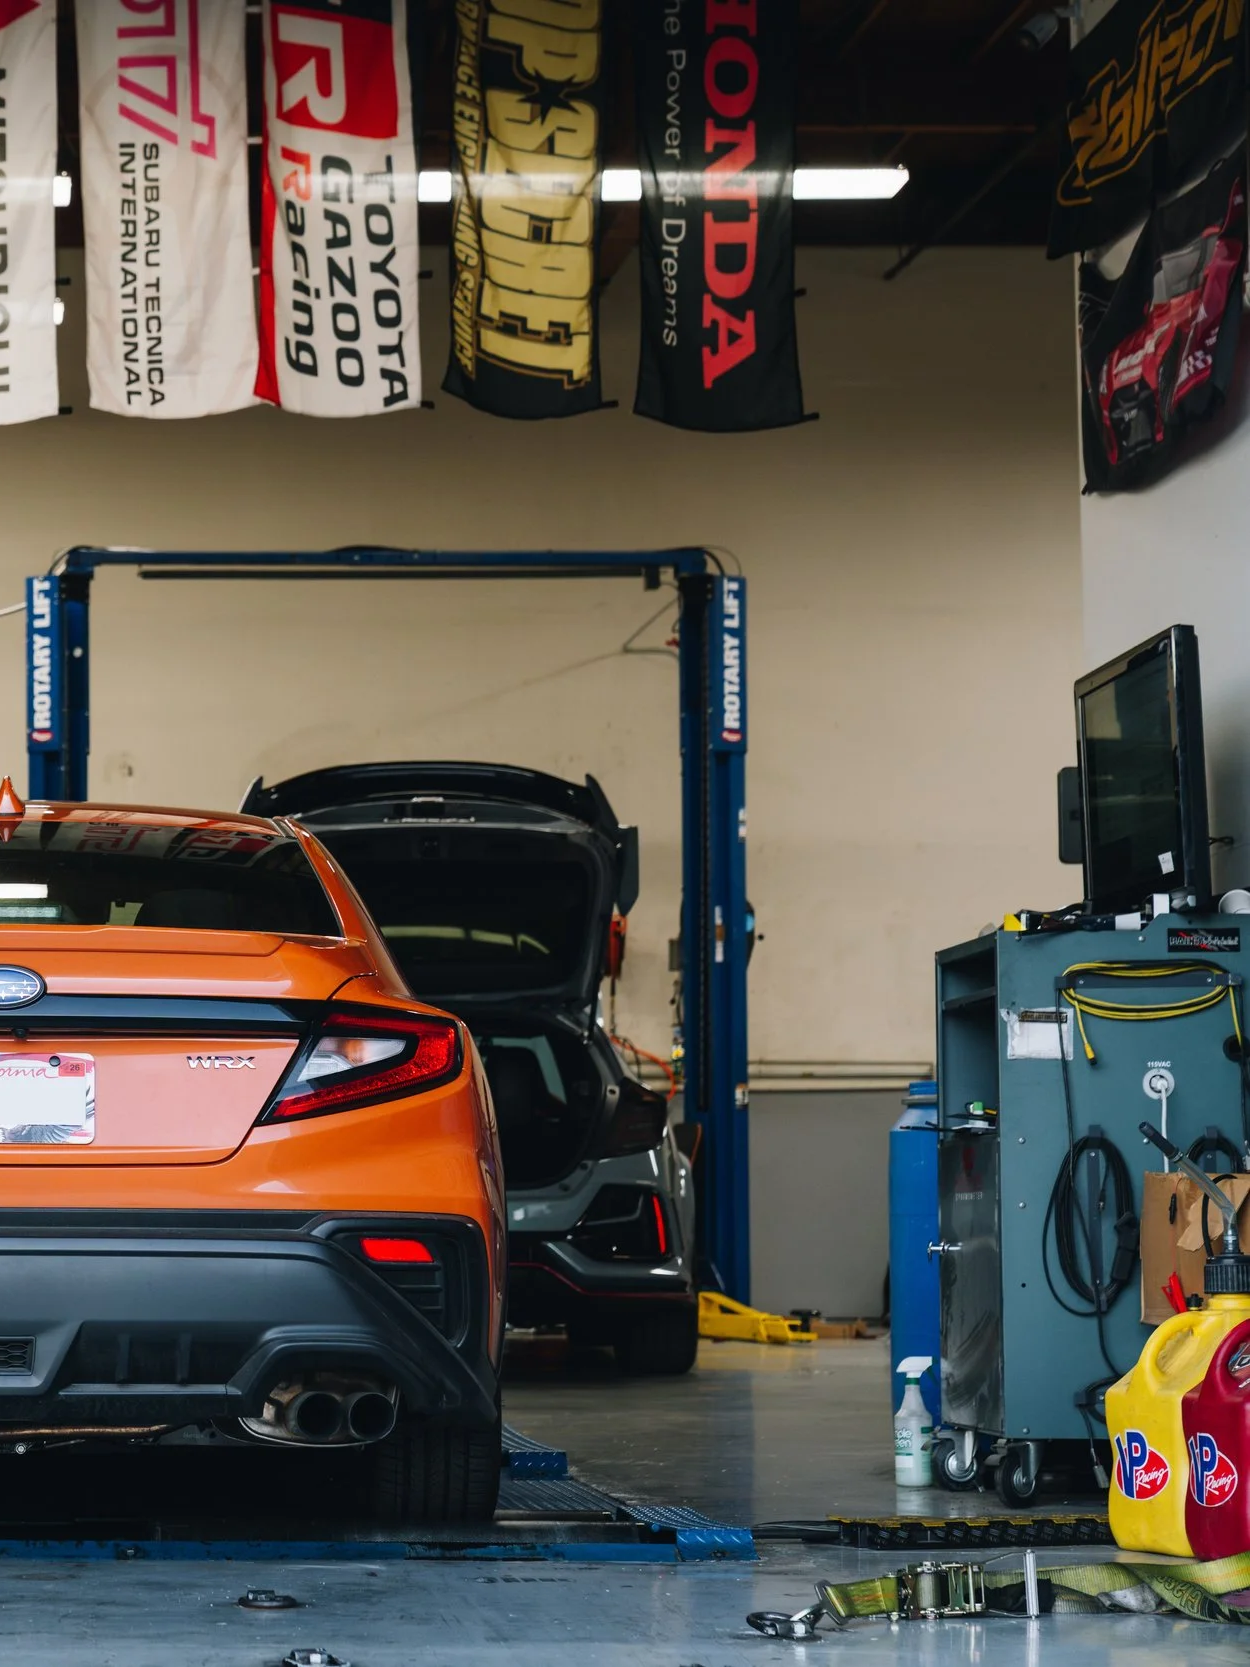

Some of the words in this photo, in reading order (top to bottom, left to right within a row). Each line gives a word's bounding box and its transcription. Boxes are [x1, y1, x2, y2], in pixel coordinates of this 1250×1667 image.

[664, 49, 687, 160] Power
[143, 142, 161, 268] SUBARU
[118, 142, 143, 406] INTERNATIONAL
[281, 145, 321, 378] Racing
[321, 154, 365, 388] GAZOO
[362, 154, 410, 408] TOYOTA
[661, 217, 687, 348] Dreams
[143, 278, 166, 407] TECNICA
[32, 578, 51, 629] LIFT
[723, 578, 740, 629] LIFT
[32, 633, 52, 730] ROTARY
[723, 633, 741, 730] ROTARY
[69, 1063, 81, 1072] 26
[186, 1056, 257, 1069] WRX
[1114, 1428, 1149, 1500] VP
[1135, 1467, 1169, 1491] Racing
[1188, 1432, 1218, 1506] VP
[1205, 1473, 1236, 1496] Racing
